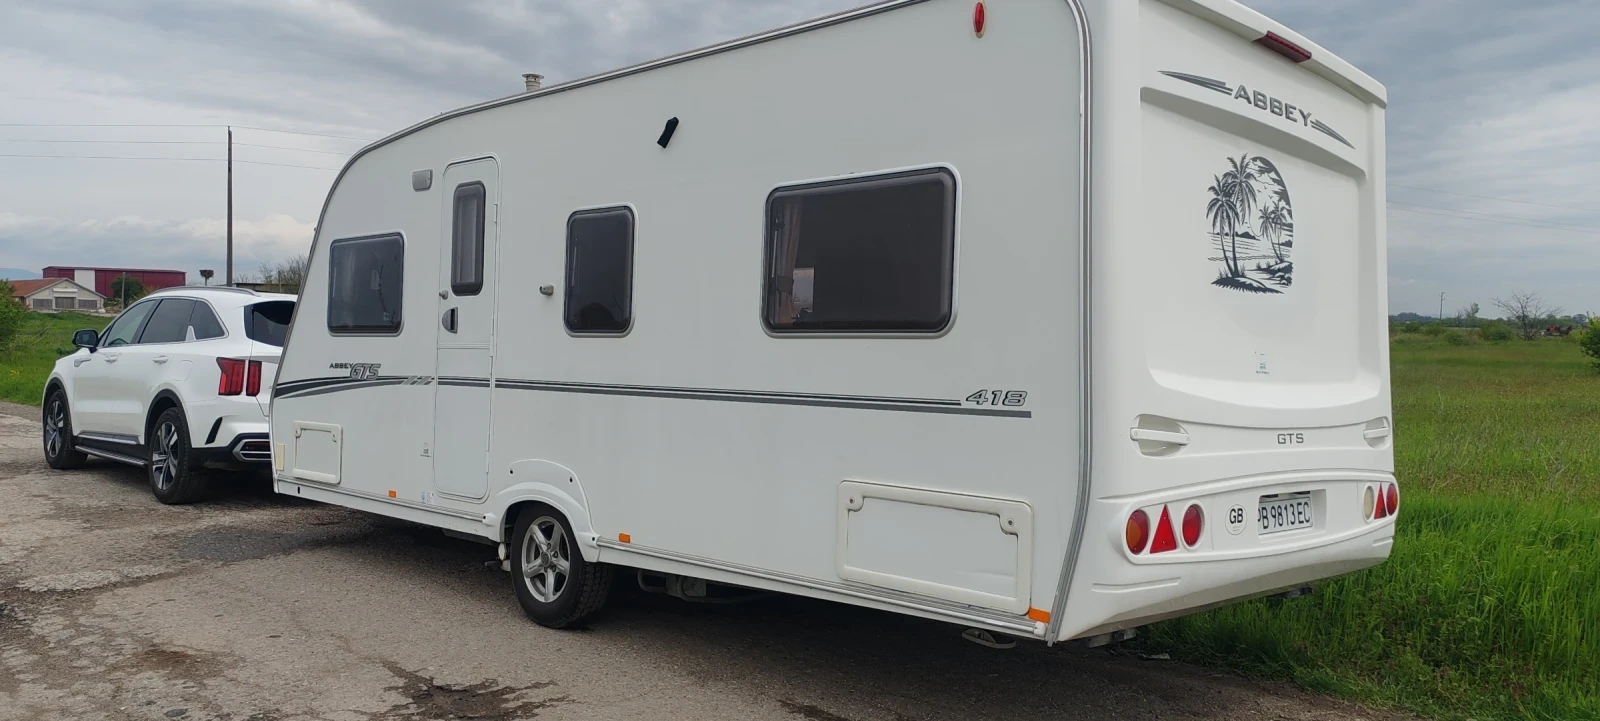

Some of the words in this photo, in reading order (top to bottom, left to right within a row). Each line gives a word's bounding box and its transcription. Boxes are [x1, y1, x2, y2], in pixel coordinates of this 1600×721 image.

[1233, 84, 1312, 127] ABBEY
[350, 362, 381, 380] GTS
[965, 389, 1028, 407] 418
[1277, 433, 1304, 445] GTS
[1229, 507, 1244, 524] GB
